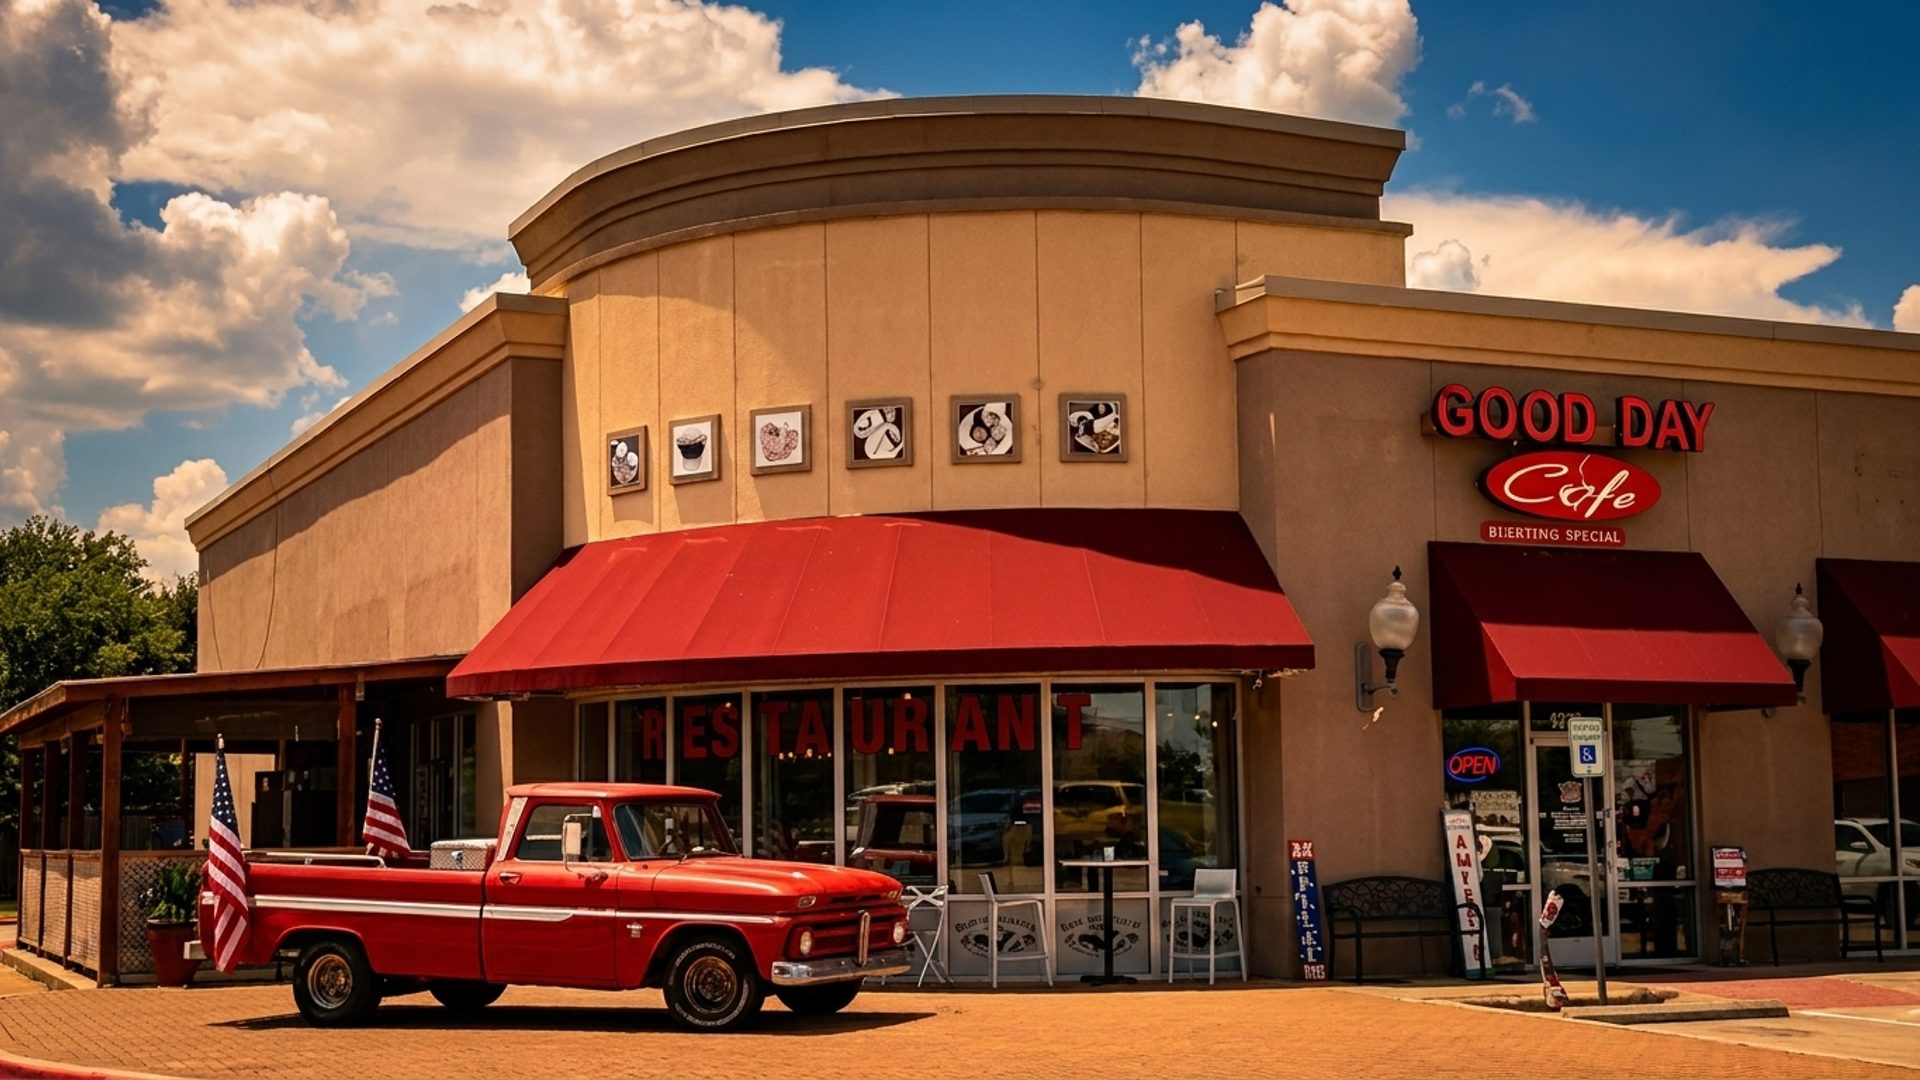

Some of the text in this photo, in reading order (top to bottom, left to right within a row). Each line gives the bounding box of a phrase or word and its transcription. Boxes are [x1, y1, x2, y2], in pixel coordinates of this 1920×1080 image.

[1432, 384, 1715, 452] GOOD DAY
[1503, 461, 1636, 519] Cafe
[1565, 529, 1621, 544] SPECIAL
[641, 693, 1092, 760] RESTAURANT
[1449, 755, 1497, 775] OPEN
